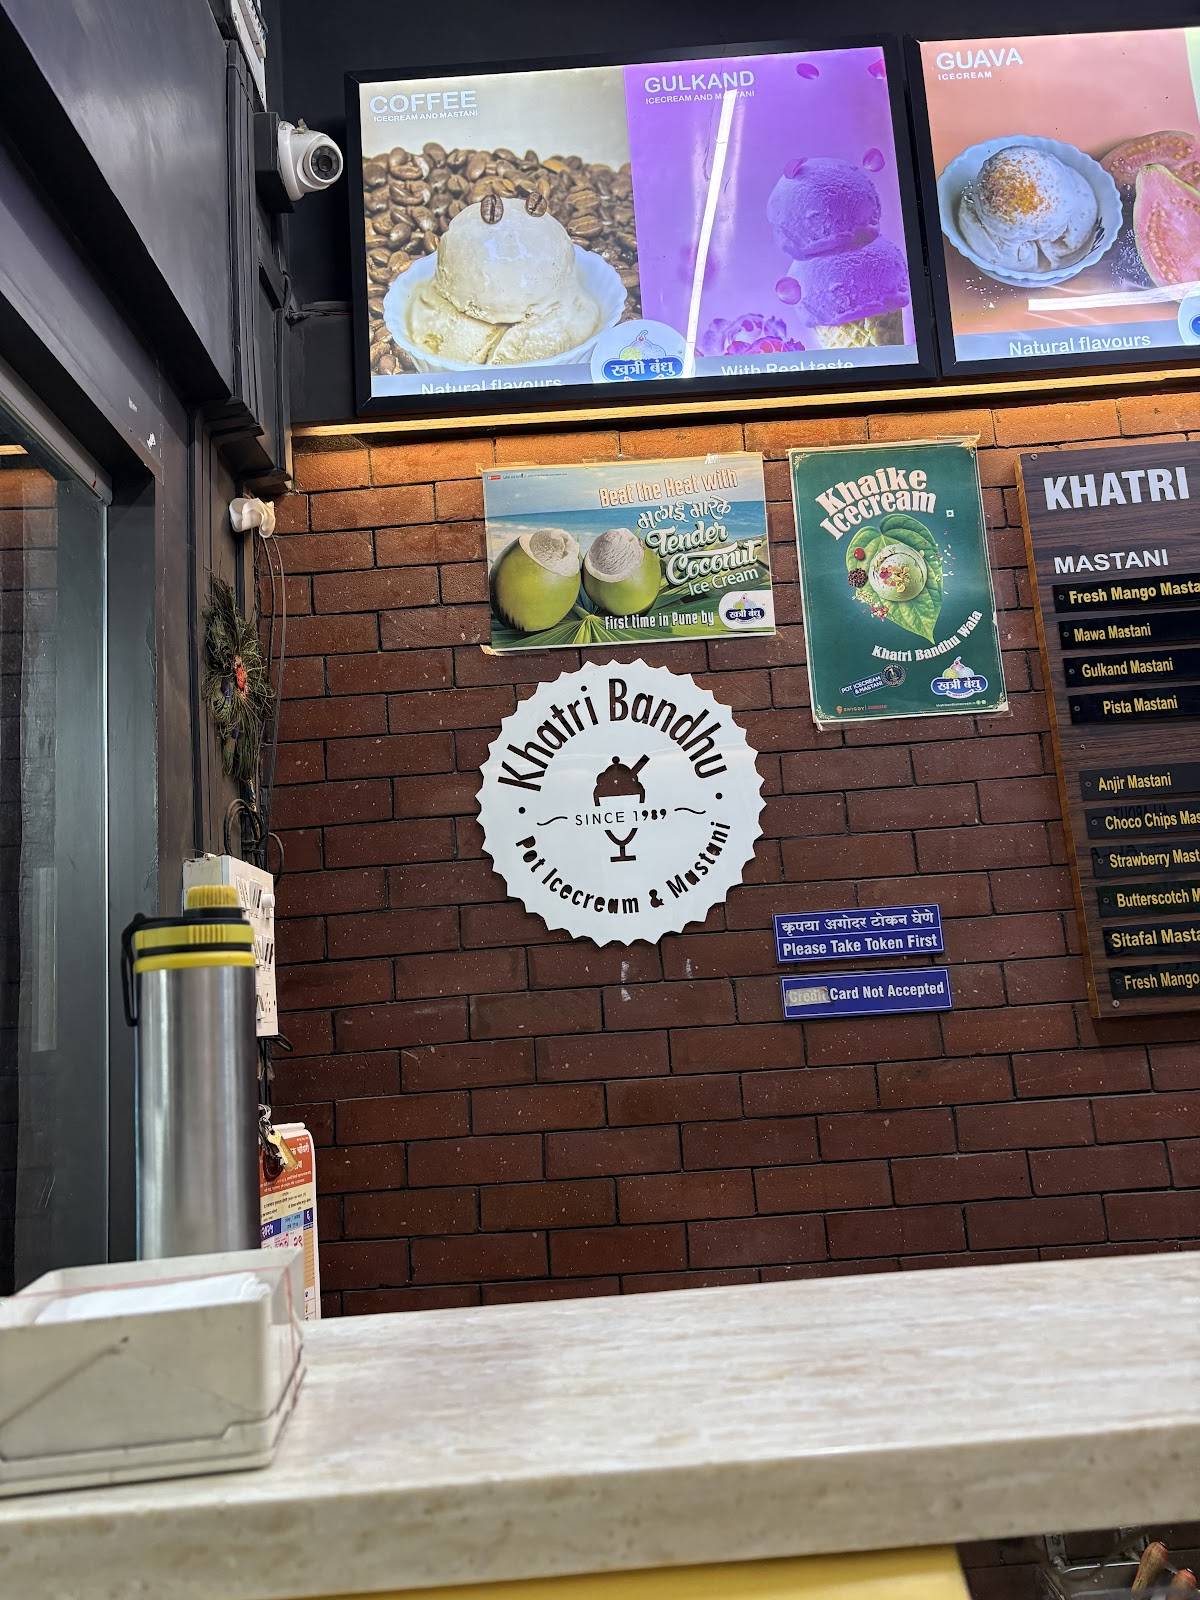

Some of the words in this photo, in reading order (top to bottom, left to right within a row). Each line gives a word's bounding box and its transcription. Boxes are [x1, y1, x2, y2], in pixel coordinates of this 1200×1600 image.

[936, 47, 1024, 70] GUAVA
[644, 70, 755, 93] GULKAND
[938, 71, 992, 80] ICECREAM
[369, 90, 477, 114] COFFEE
[645, 95, 692, 104] ICECREAM
[693, 92, 713, 101] AND
[374, 113, 418, 122] ICECREAM
[419, 112, 439, 121] AND
[440, 109, 478, 119] MASTANI
[1009, 337, 1075, 356] Natural
[1079, 335, 1151, 351] flavours
[610, 360, 646, 376] खत्री
[649, 359, 676, 376] बंधु
[599, 483, 634, 508] Beat
[636, 481, 662, 502] the
[664, 473, 700, 498] Heat
[701, 468, 739, 492] with
[815, 467, 927, 517] Khaike
[1043, 466, 1190, 511] KHATRI
[820, 490, 937, 541] Icecream
[645, 521, 729, 557] Tender
[666, 539, 763, 586] Coconut
[1054, 549, 1169, 574] MASTANI
[688, 581, 711, 596] Ice
[712, 568, 759, 589] Cream
[1069, 588, 1107, 604] Fresh
[1111, 584, 1157, 602] Mango
[604, 615, 629, 630] First
[632, 614, 656, 629] time
[658, 612, 669, 626] in
[672, 611, 698, 626] Pune
[701, 610, 715, 626] by
[871, 644, 912, 662] Khatri
[915, 635, 962, 661] Bandhu
[956, 610, 983, 638] Wala
[1074, 627, 1106, 642] Mawa
[1108, 622, 1152, 639] Mastani
[1082, 661, 1127, 678] Gulkand
[1130, 657, 1173, 673] Mastani
[853, 675, 881, 689] ICECREAM
[937, 678, 961, 690] खत्री
[963, 677, 983, 690] बंधु
[1103, 699, 1132, 715] Pista
[1134, 695, 1178, 712] Mastani
[497, 685, 600, 792] Khatri
[608, 678, 728, 779] Bandhu
[1098, 775, 1125, 794] Anjir
[1127, 772, 1172, 789] Mastani
[575, 811, 625, 826] SINCE
[633, 808, 667, 823] 1989
[1105, 815, 1142, 830] Choco
[1144, 812, 1177, 829] Chips
[515, 835, 546, 873] Pot
[542, 868, 640, 914] Icecream
[649, 888, 665, 908] &
[665, 821, 731, 899] Mastani
[1109, 852, 1169, 868] Strawberry
[1116, 888, 1189, 908] Butterscotch
[781, 919, 820, 936] कृपया
[824, 914, 867, 930] अगोदर
[870, 912, 907, 927] टोकन
[783, 941, 827, 957] Please
[830, 939, 861, 953] Take
[864, 936, 904, 951] Token
[907, 933, 938, 949] First
[1111, 929, 1158, 948] Sitafal
[829, 986, 859, 1001] Card
[863, 985, 884, 999] Not
[887, 981, 945, 998] Accepted
[1124, 974, 1158, 990] Fresh
[1160, 971, 1200, 989] Mango
